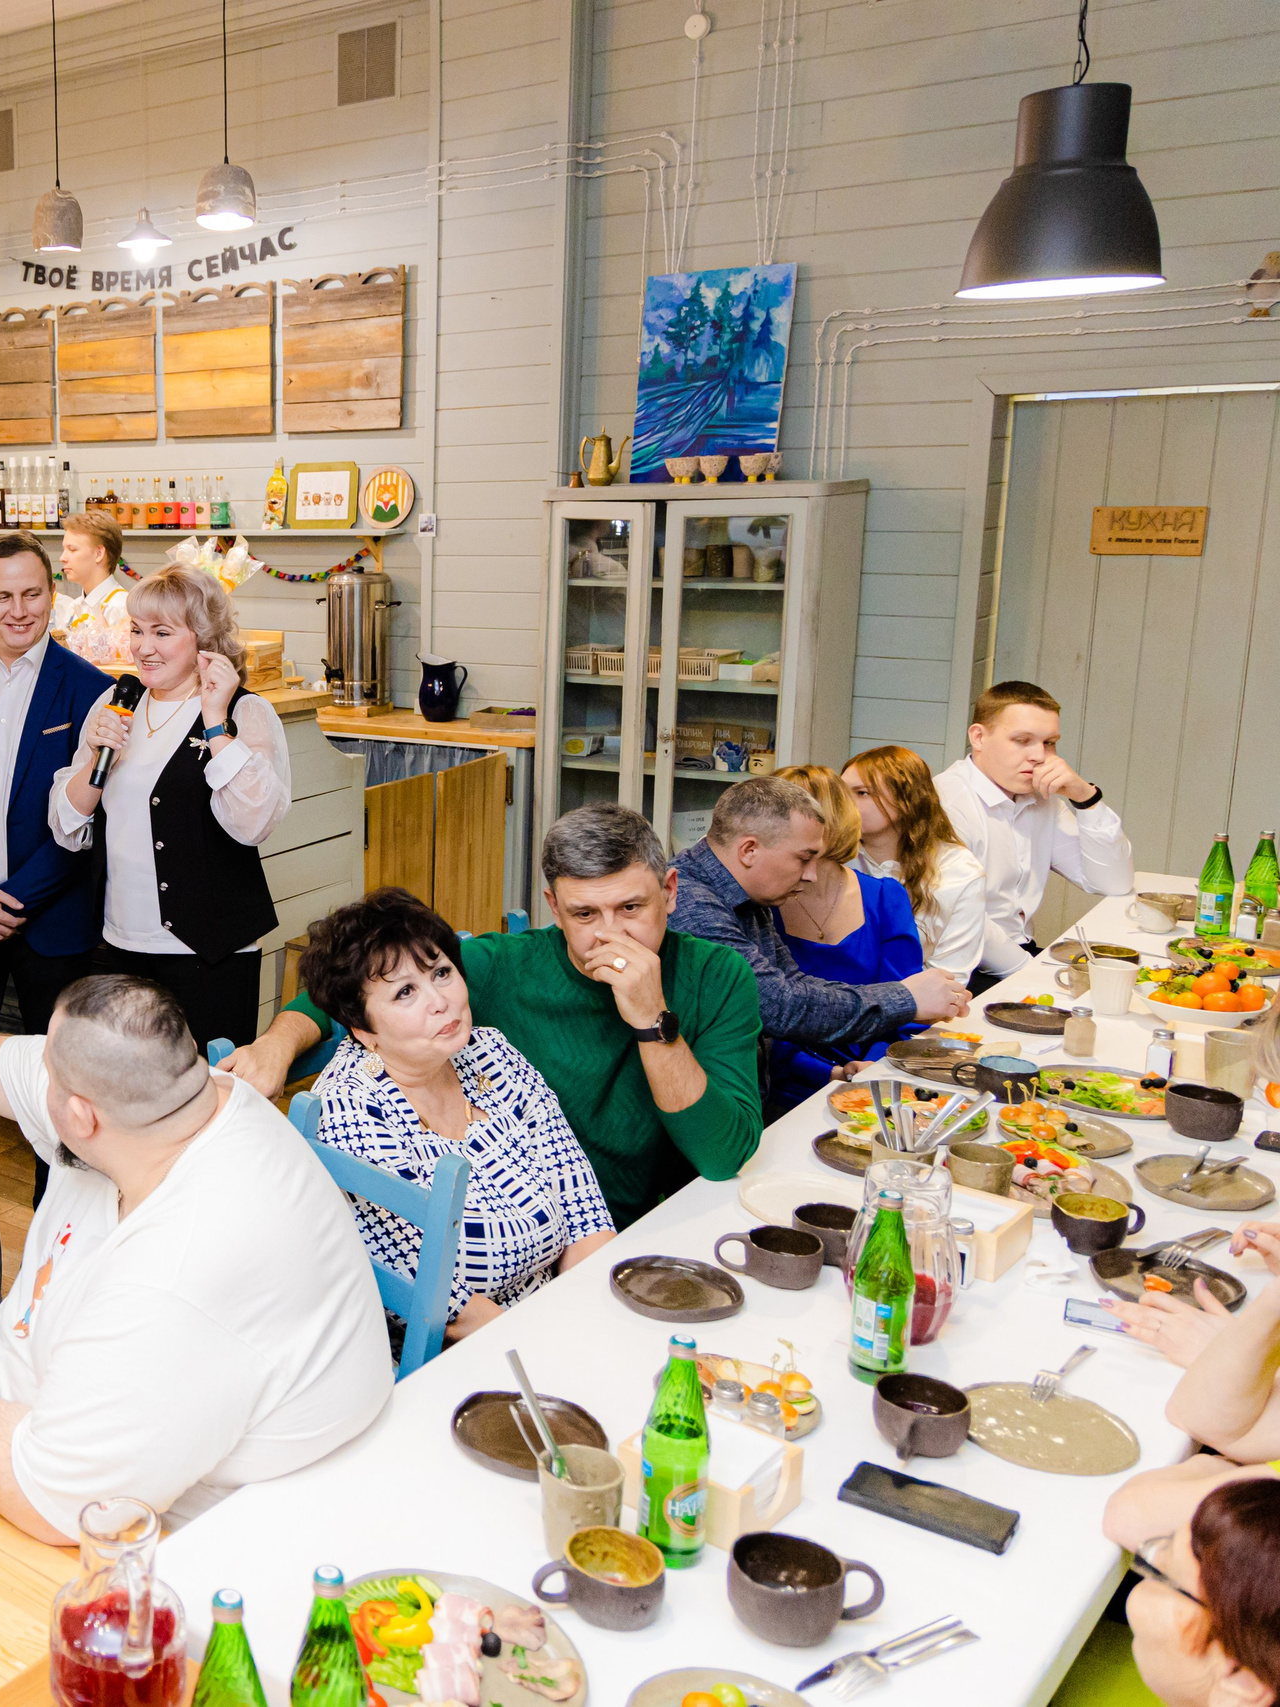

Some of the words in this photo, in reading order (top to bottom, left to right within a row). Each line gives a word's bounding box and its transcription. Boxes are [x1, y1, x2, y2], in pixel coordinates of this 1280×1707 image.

[22, 261, 78, 290] ТВОЁ
[91, 265, 172, 292] ВРЕМЯ
[187, 226, 298, 282] СЕЙЧАС
[1109, 510, 1196, 532] КУХНЯ
